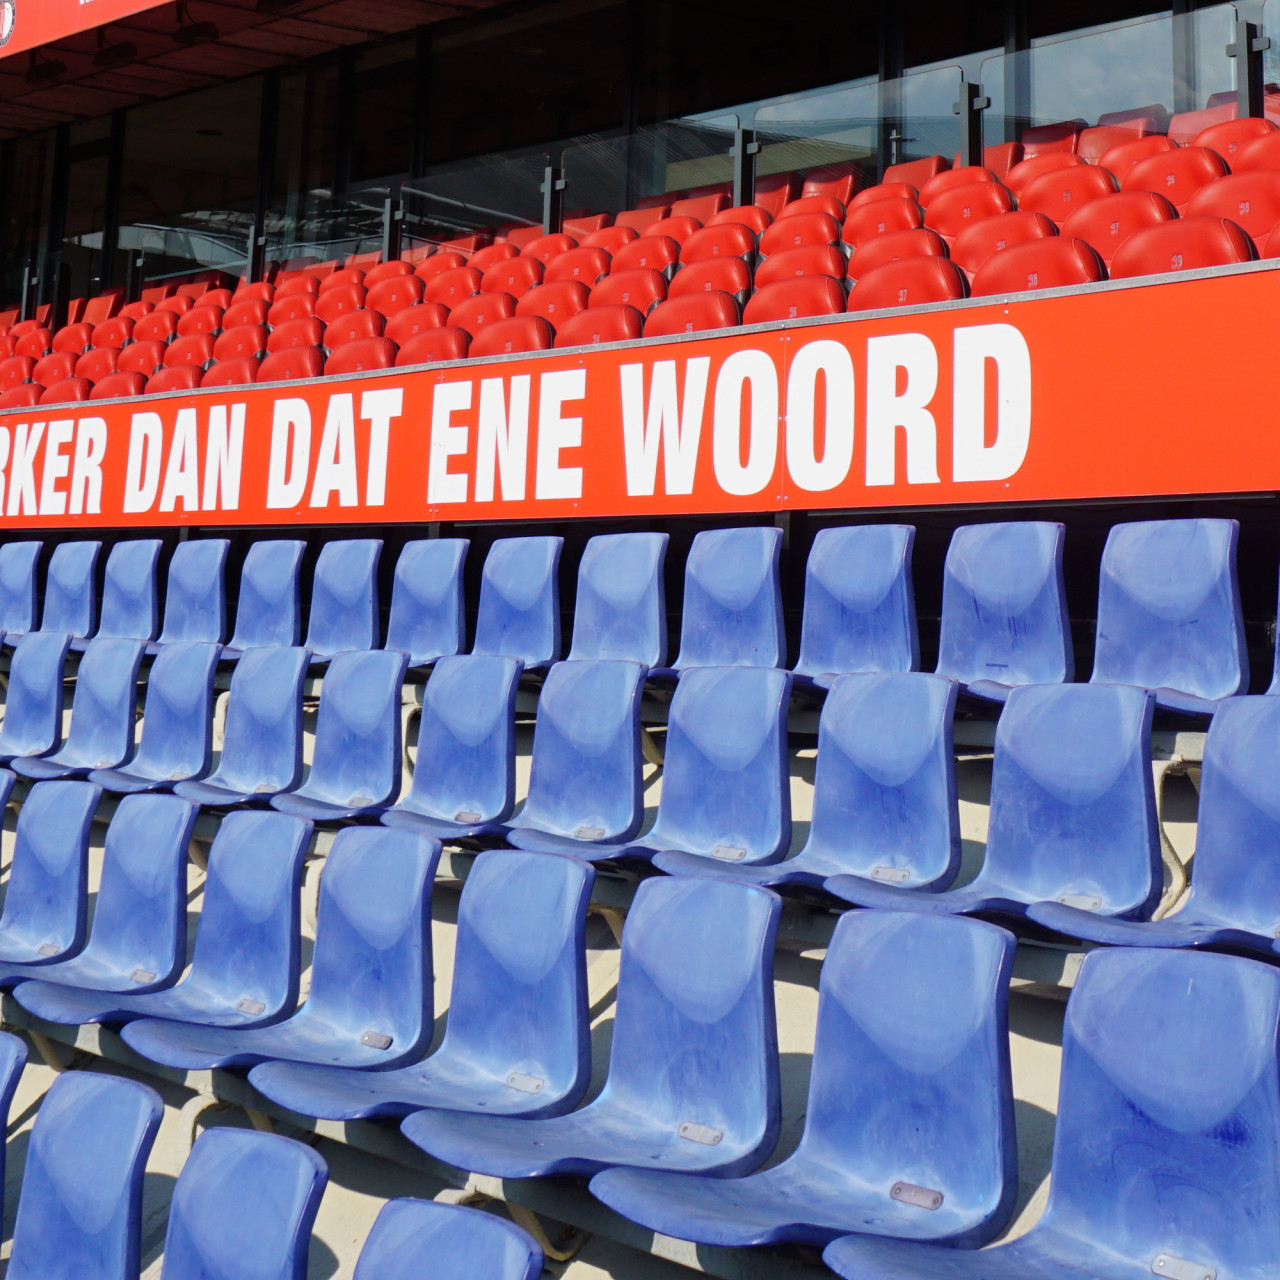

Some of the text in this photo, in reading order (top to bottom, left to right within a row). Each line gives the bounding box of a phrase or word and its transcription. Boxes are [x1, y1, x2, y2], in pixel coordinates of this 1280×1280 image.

[123, 404, 249, 514] DAN
[266, 388, 405, 510] DAT
[431, 369, 586, 505] ENE
[619, 324, 1032, 498] WOORD
